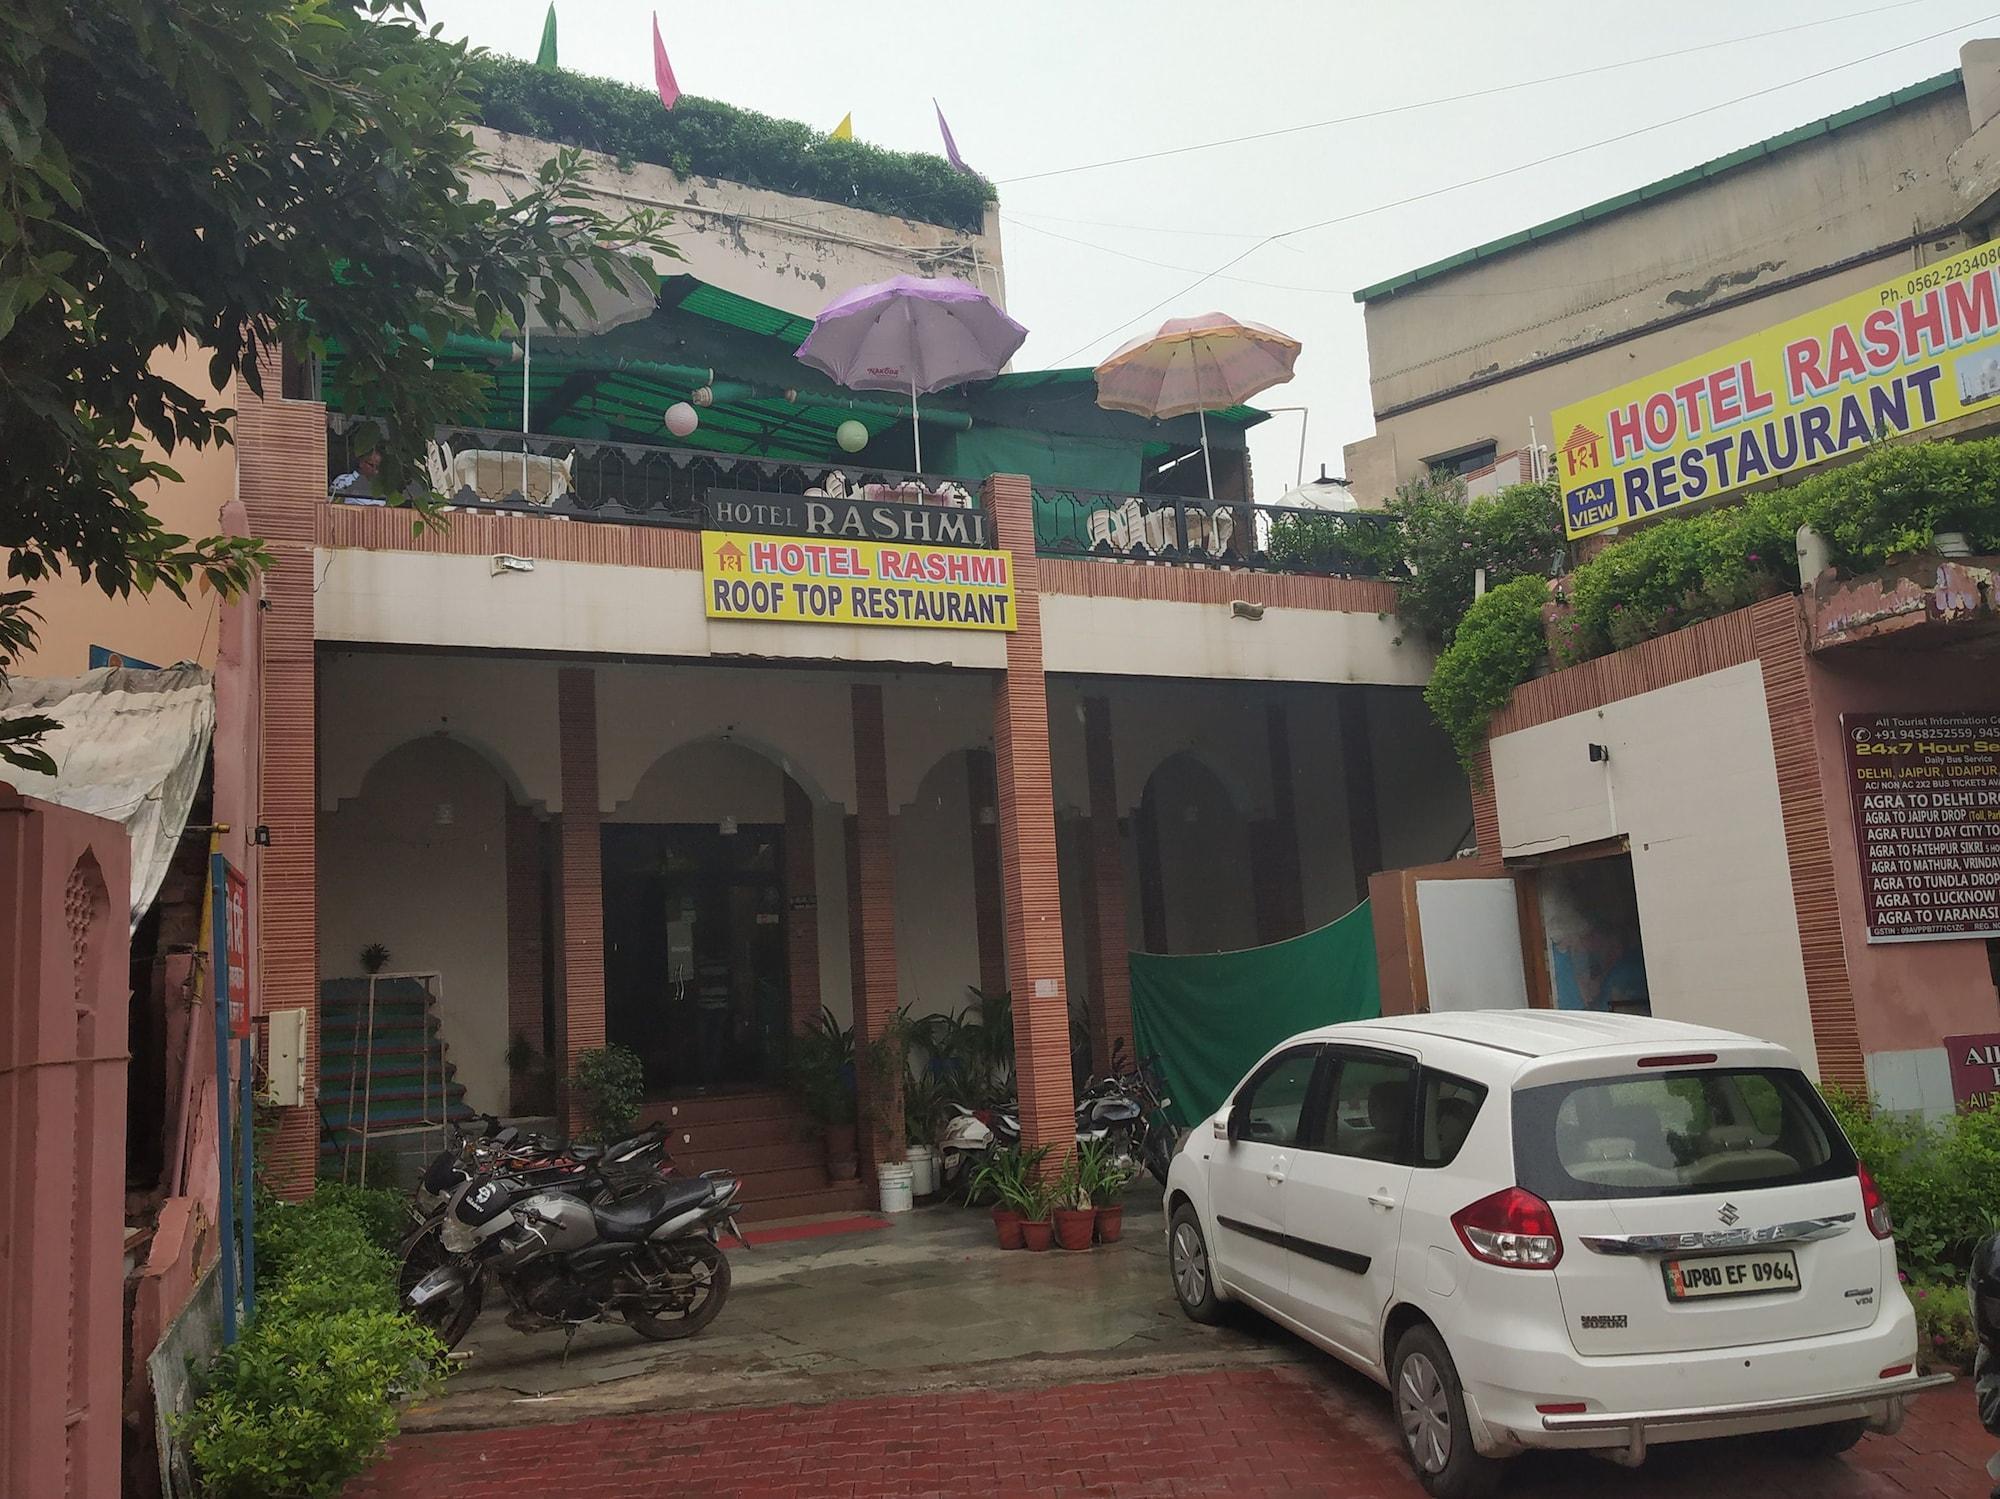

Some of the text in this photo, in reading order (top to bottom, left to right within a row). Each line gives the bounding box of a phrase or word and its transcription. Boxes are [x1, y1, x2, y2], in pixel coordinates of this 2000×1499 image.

[1880, 288, 1903, 306] Ph.
[1608, 266, 2000, 464] HOTEL RASHM
[1622, 364, 1941, 518] RESTAURANT
[1575, 483, 1606, 506] TAJ
[717, 501, 988, 546] HOTEL RASHMI
[1572, 501, 1614, 528] VIEW
[751, 542, 1008, 585] HOTEL RASHMI
[713, 579, 1009, 625] ROOF TOP RESTAURANT
[1876, 718, 1889, 727] All
[1893, 717, 1928, 727] Tourist
[1930, 715, 1988, 726] Information
[1875, 730, 1897, 740] +91
[1856, 742, 1914, 756] 24x7
[1919, 742, 1970, 754] Hour
[1925, 754, 1993, 765] Daily Bus Service
[1881, 781, 1900, 789] NON
[1902, 780, 1914, 789] AC
[1933, 779, 1950, 788] BUS
[1952, 778, 1987, 787] TICKETS
[1864, 791, 2000, 809] AGRA TO DELHI DR
[1866, 811, 1891, 824] AGRA
[1893, 810, 1906, 823] TO
[1908, 809, 1940, 823] JAIPUR
[1941, 808, 1967, 821] DROP
[1868, 828, 1899, 841] AGRA
[1901, 826, 1932, 839] FULLY
[1935, 825, 1957, 838] DAY
[1960, 825, 1983, 837] CITY
[1870, 845, 1896, 857] AGRA
[1897, 844, 1910, 856] TO
[1912, 842, 1959, 855] FATEHPUR
[1960, 841, 1984, 854] SIKRI
[1872, 861, 1898, 873] AGRA
[1899, 860, 1911, 872] TO
[1914, 858, 1962, 871] MATHURA,
[1874, 872, 2000, 891] AGRA TO TUNDLA DROP
[1876, 889, 1996, 908] AGRA TO LUCKNOW
[1878, 906, 1999, 925] AGRA TO VARANASI
[1681, 1261, 1795, 1288] UP80 EF 0964
